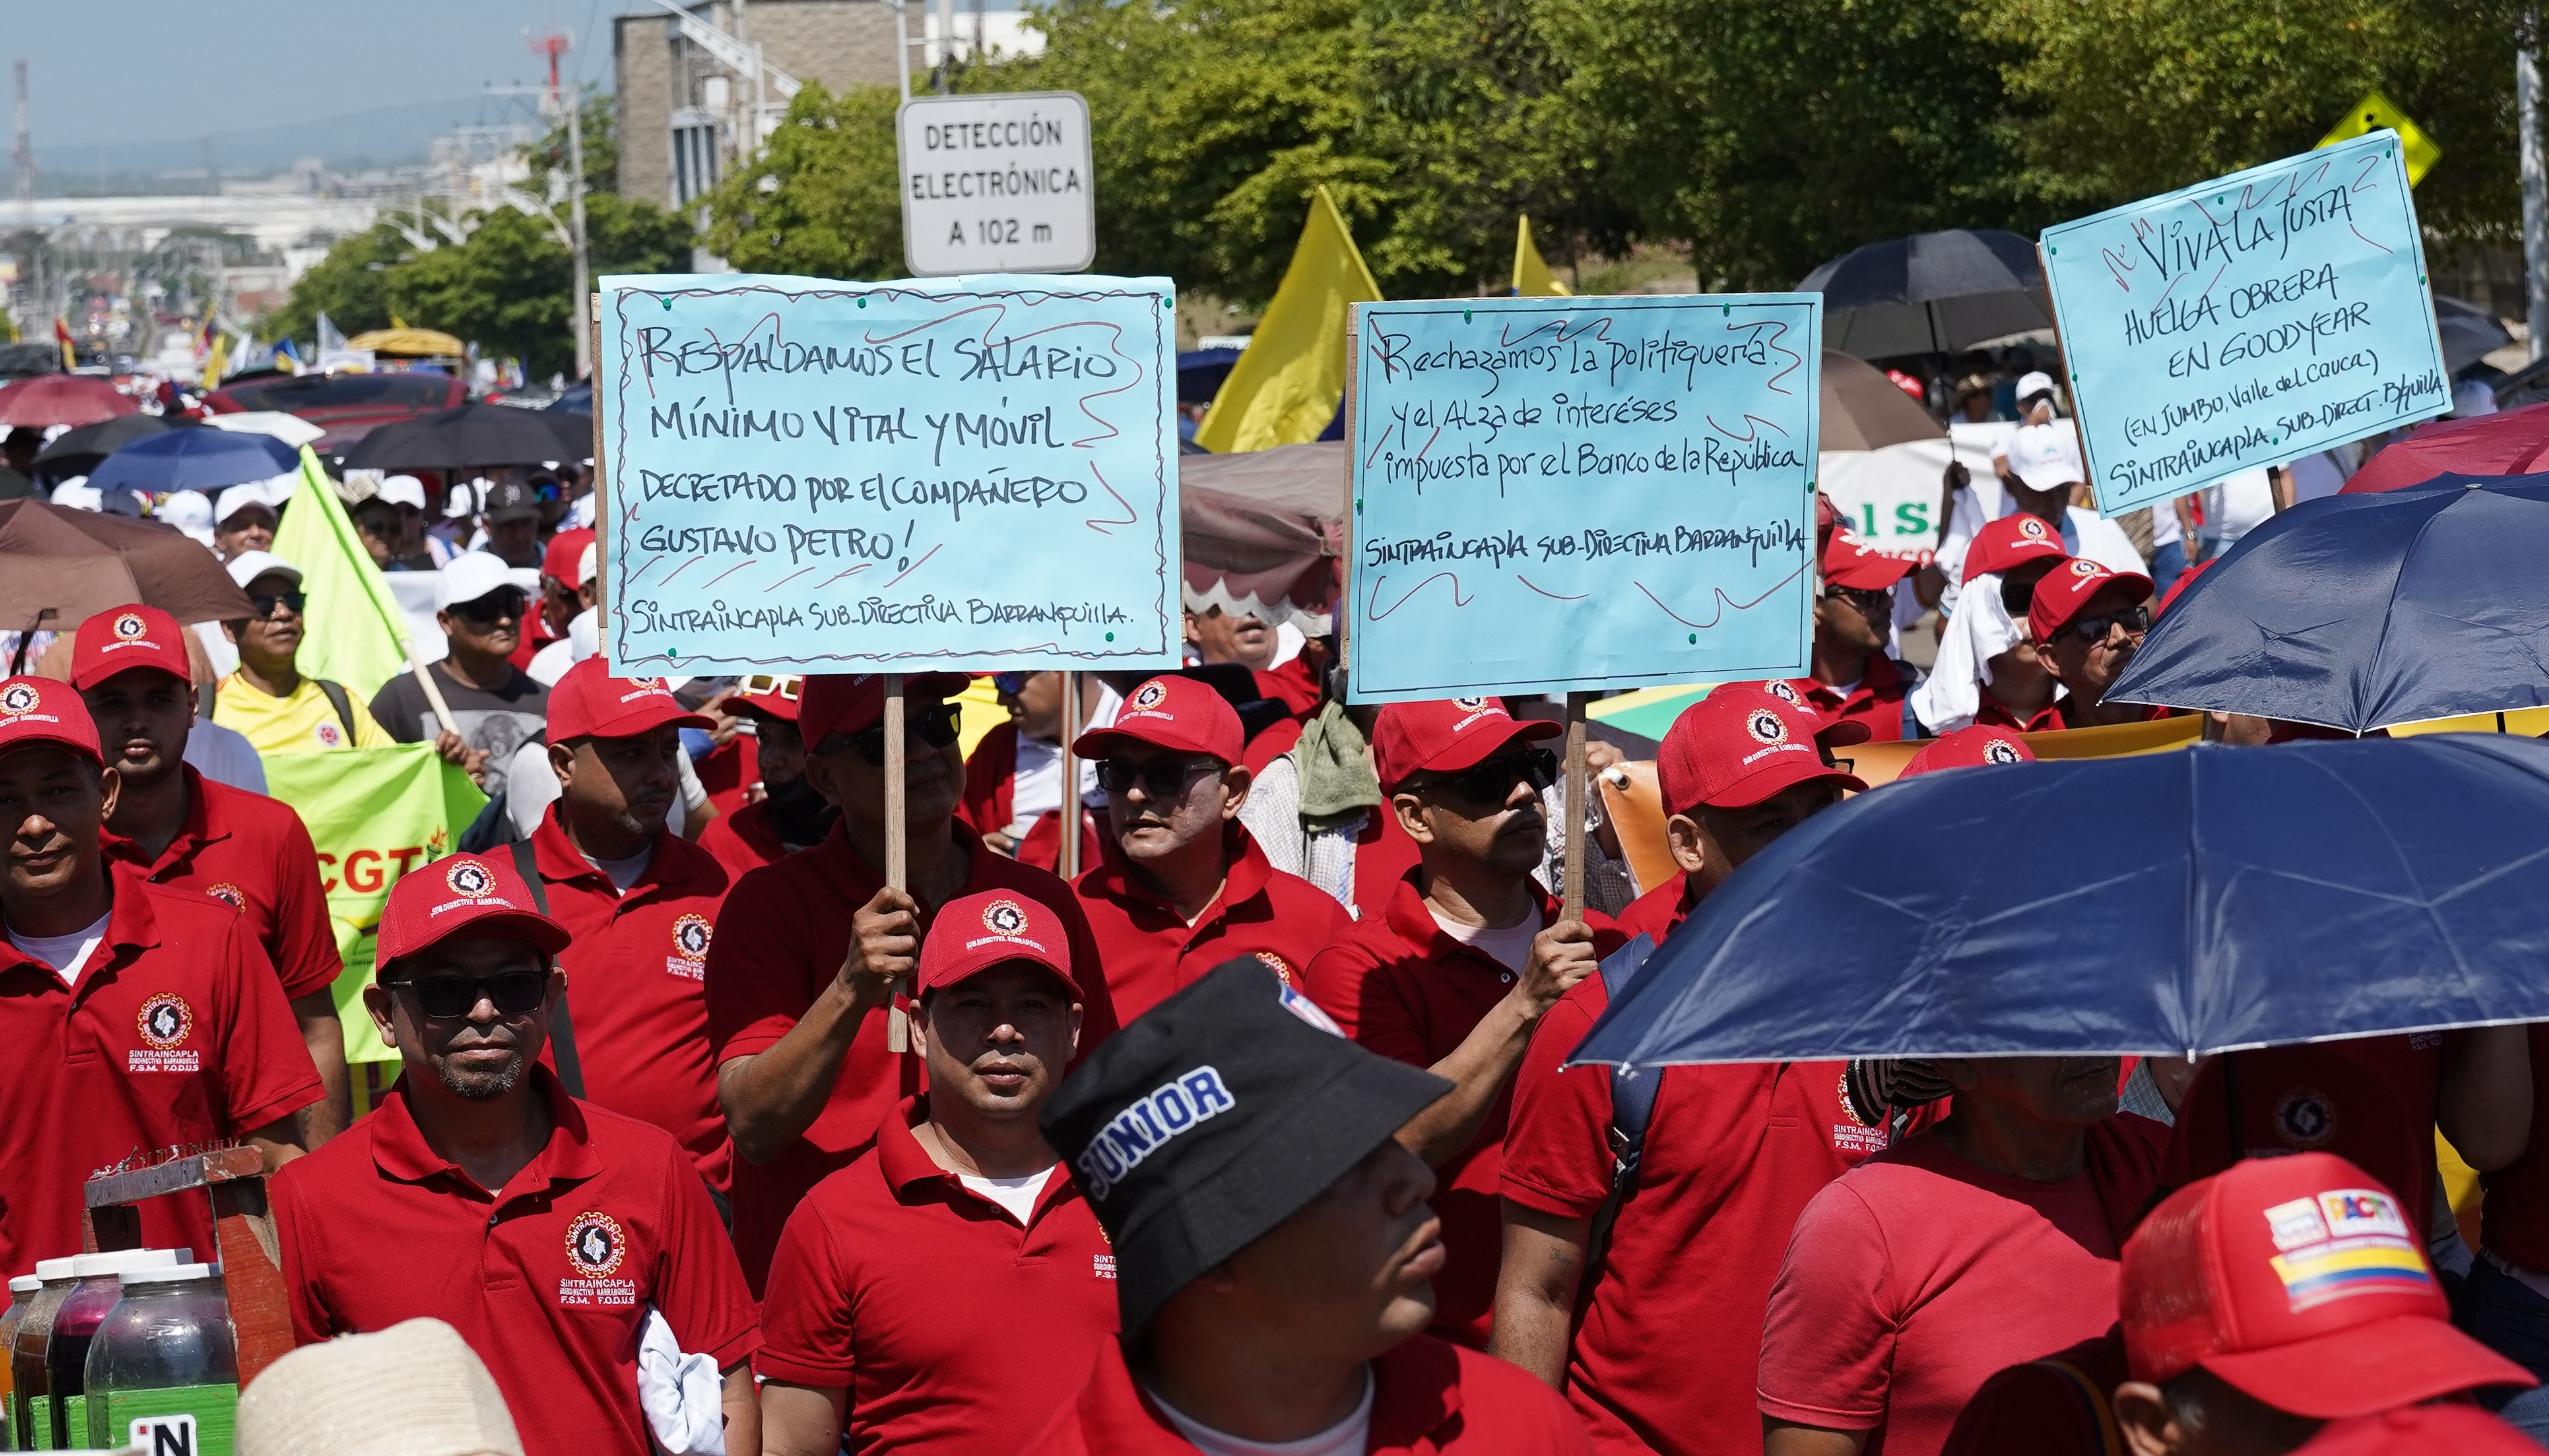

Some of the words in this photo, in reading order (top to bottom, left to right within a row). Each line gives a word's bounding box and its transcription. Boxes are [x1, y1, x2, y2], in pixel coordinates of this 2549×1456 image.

[926, 111, 1062, 150] DETECCIÓN
[912, 161, 1081, 199] ELECTRÓNICA
[948, 221, 966, 246] A
[977, 218, 1020, 245] 102
[1032, 223, 1052, 243] m
[2125, 295, 2221, 346] HUELGA
[2230, 262, 2339, 321] OBRERA
[2168, 341, 2210, 379] EN
[1384, 451, 1490, 495] impuesta
[1499, 453, 1536, 498] por
[1541, 444, 1571, 476] el
[1578, 443, 1650, 476] Banco
[1655, 443, 1679, 473] de
[639, 469, 796, 503] DECRETADO
[805, 475, 854, 513] POR
[890, 468, 1087, 522] COMPAÑERO
[640, 526, 776, 557] GUSTAVO
[128, 1049, 199, 1058] SINTRAINCAPLA
[1076, 1065, 1236, 1201] JUNIOR
[560, 1278, 635, 1288] SINTRAINCAPLA
